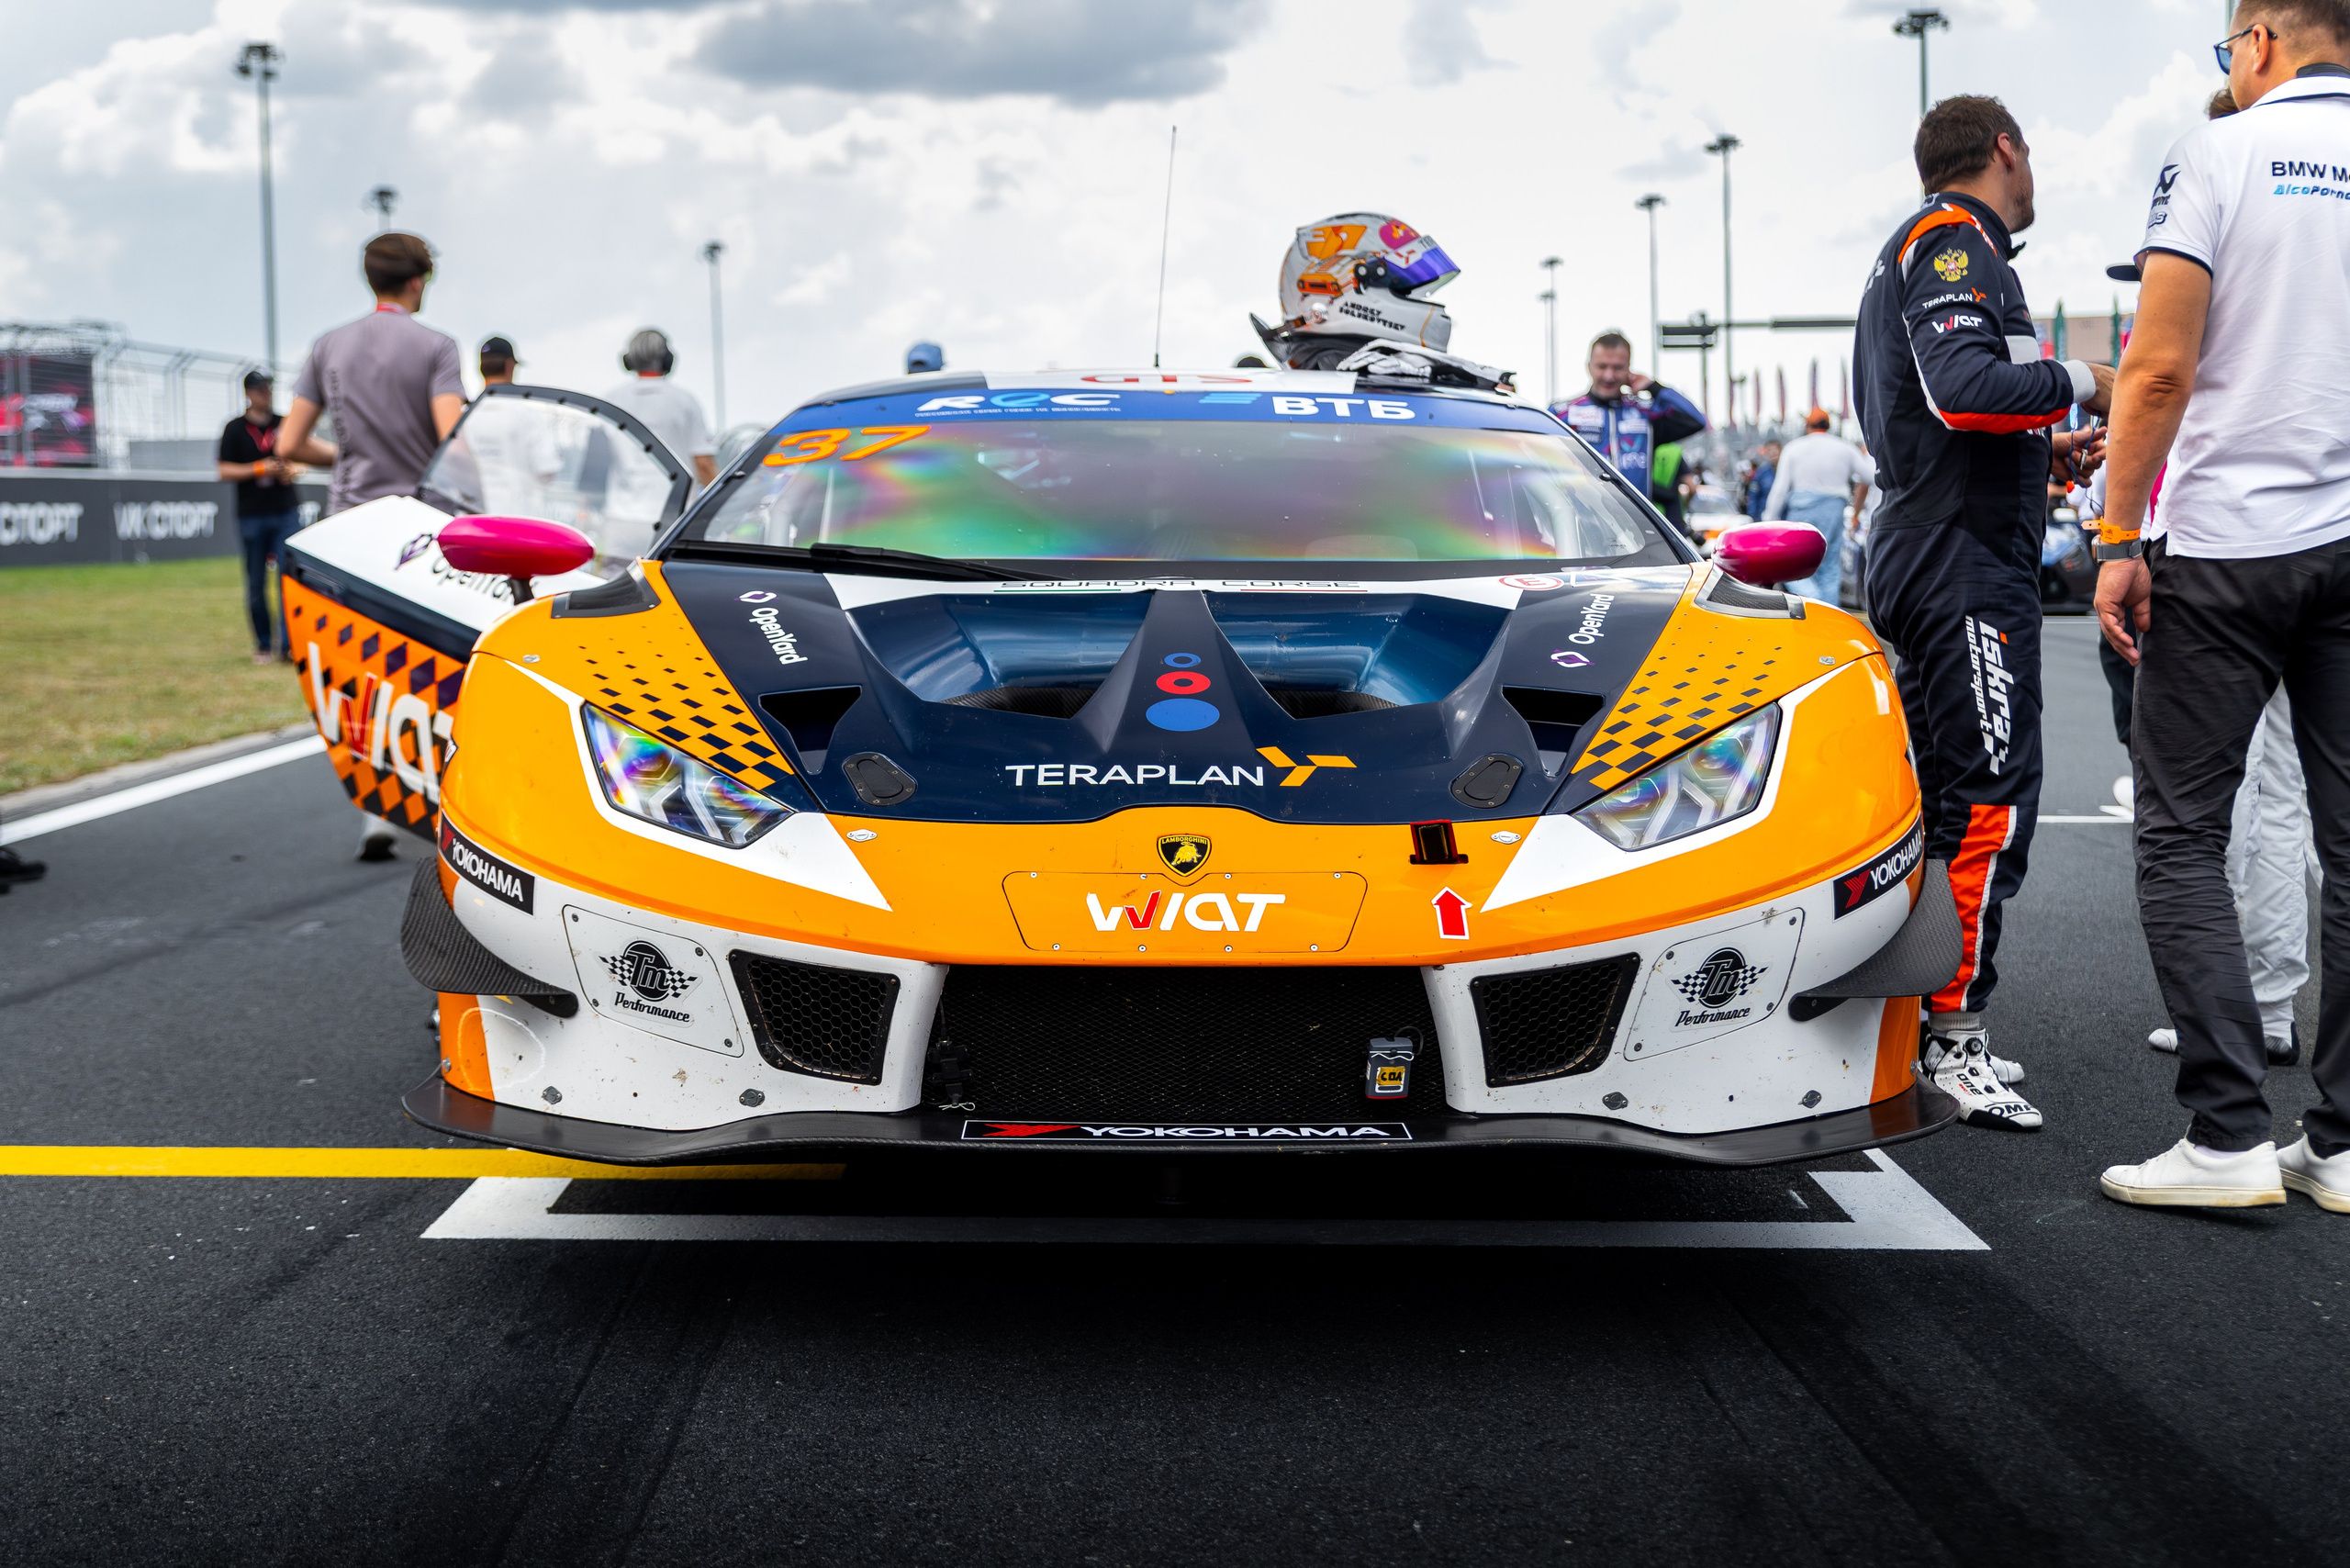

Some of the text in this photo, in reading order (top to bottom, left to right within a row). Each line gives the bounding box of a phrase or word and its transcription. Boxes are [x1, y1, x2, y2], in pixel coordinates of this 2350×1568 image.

[2271, 161, 2350, 183] BMW M
[1921, 293, 1973, 309] TERAPLAN
[762, 425, 931, 466] 37
[1568, 593, 1615, 644] OpenYard
[749, 607, 808, 665] OpenYard
[1964, 615, 1993, 733] motorsport
[1005, 764, 1264, 787] TERAPLAN
[1161, 836, 1207, 845] LAMBORGHINI
[453, 838, 523, 902] YOKOHAMA
[1870, 830, 1923, 890] YOKOHAMA
[614, 991, 690, 1023] Performance
[1674, 1006, 1751, 1027] Performance
[1956, 1073, 1983, 1095] one
[1080, 1126, 1391, 1137] YOKOHAMA
